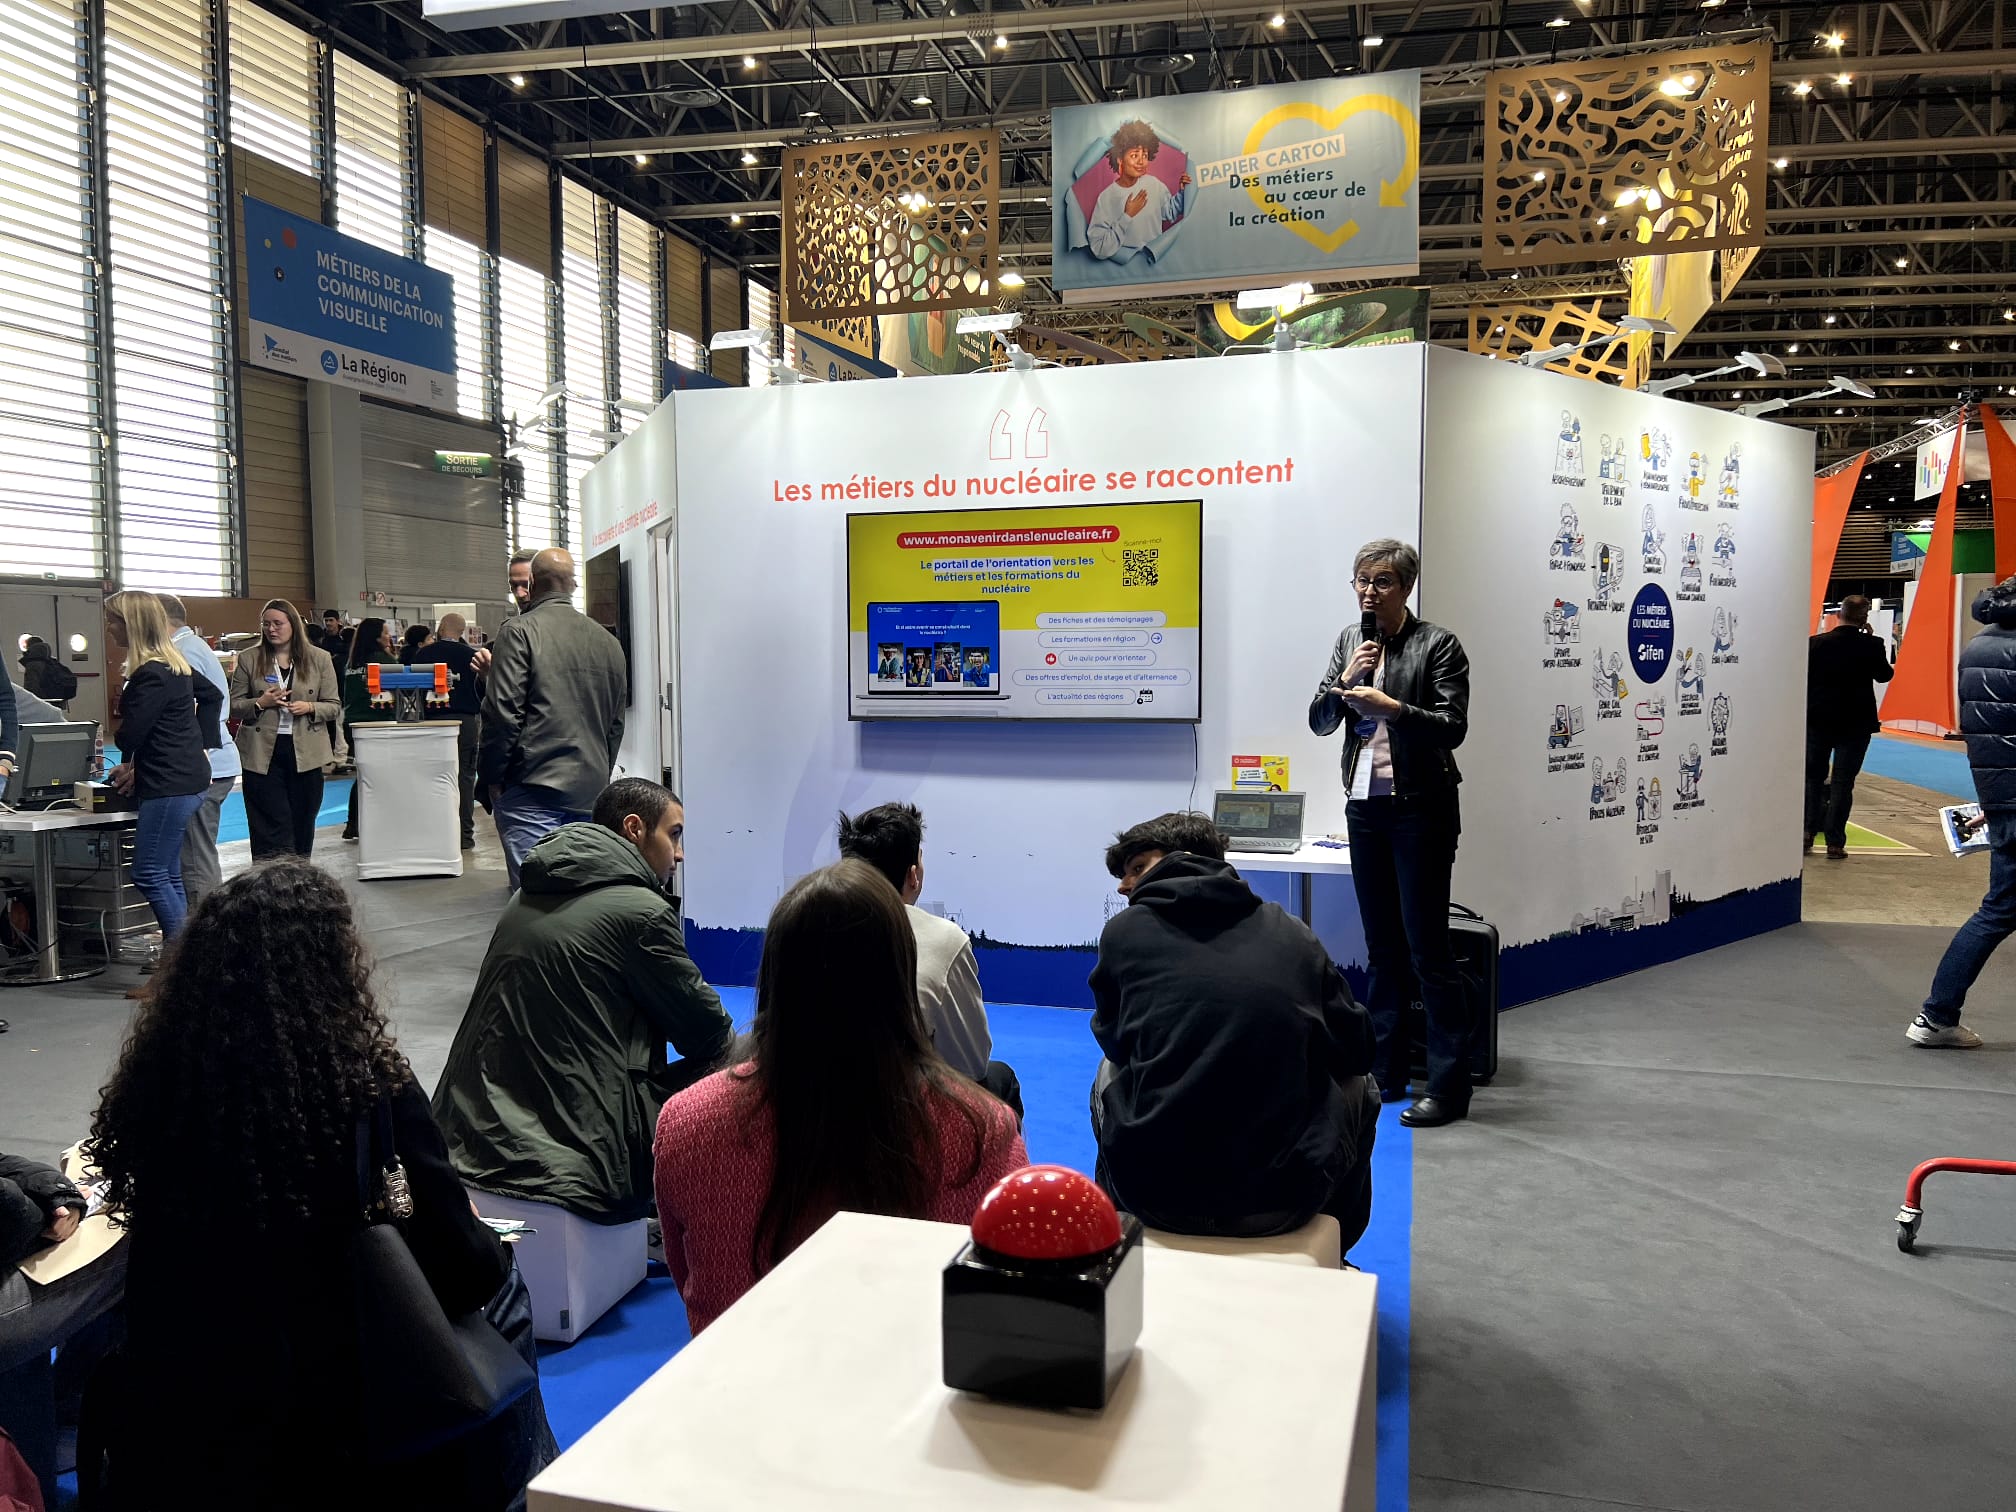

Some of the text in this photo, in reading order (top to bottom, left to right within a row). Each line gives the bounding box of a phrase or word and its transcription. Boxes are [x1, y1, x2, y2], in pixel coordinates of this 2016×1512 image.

[1200, 138, 1342, 183] PAPIER CARTON
[1229, 168, 1333, 189] Des métiers
[1264, 181, 1366, 204] au cœur de
[1229, 206, 1325, 227] la création
[316, 250, 422, 302] MÉTIERS DE LA
[317, 275, 443, 328] COMMUNICATION
[318, 297, 388, 333] VISUELLE
[342, 353, 407, 385] La Région
[446, 454, 479, 466] SORTIE
[452, 466, 483, 474] SECOURS
[774, 457, 1294, 502] Les métiers du nucléaire se racontent
[904, 529, 1112, 546] www.monavenirdanslenucleaire.fr
[920, 556, 1094, 571] Le portail de l'orientation vers les
[934, 570, 1080, 582] métiers et les formations du
[981, 584, 1030, 594] nucléaire
[1637, 604, 1646, 614] LES
[1647, 603, 1667, 615] MÉTIERS
[1107, 616, 1154, 624] témoignages
[1633, 616, 1670, 628] DU NUCLÉAIRE
[1113, 635, 1136, 643] région
[1094, 655, 1112, 663] pour
[1104, 674, 1124, 682] stage
[1097, 693, 1124, 701] régions
